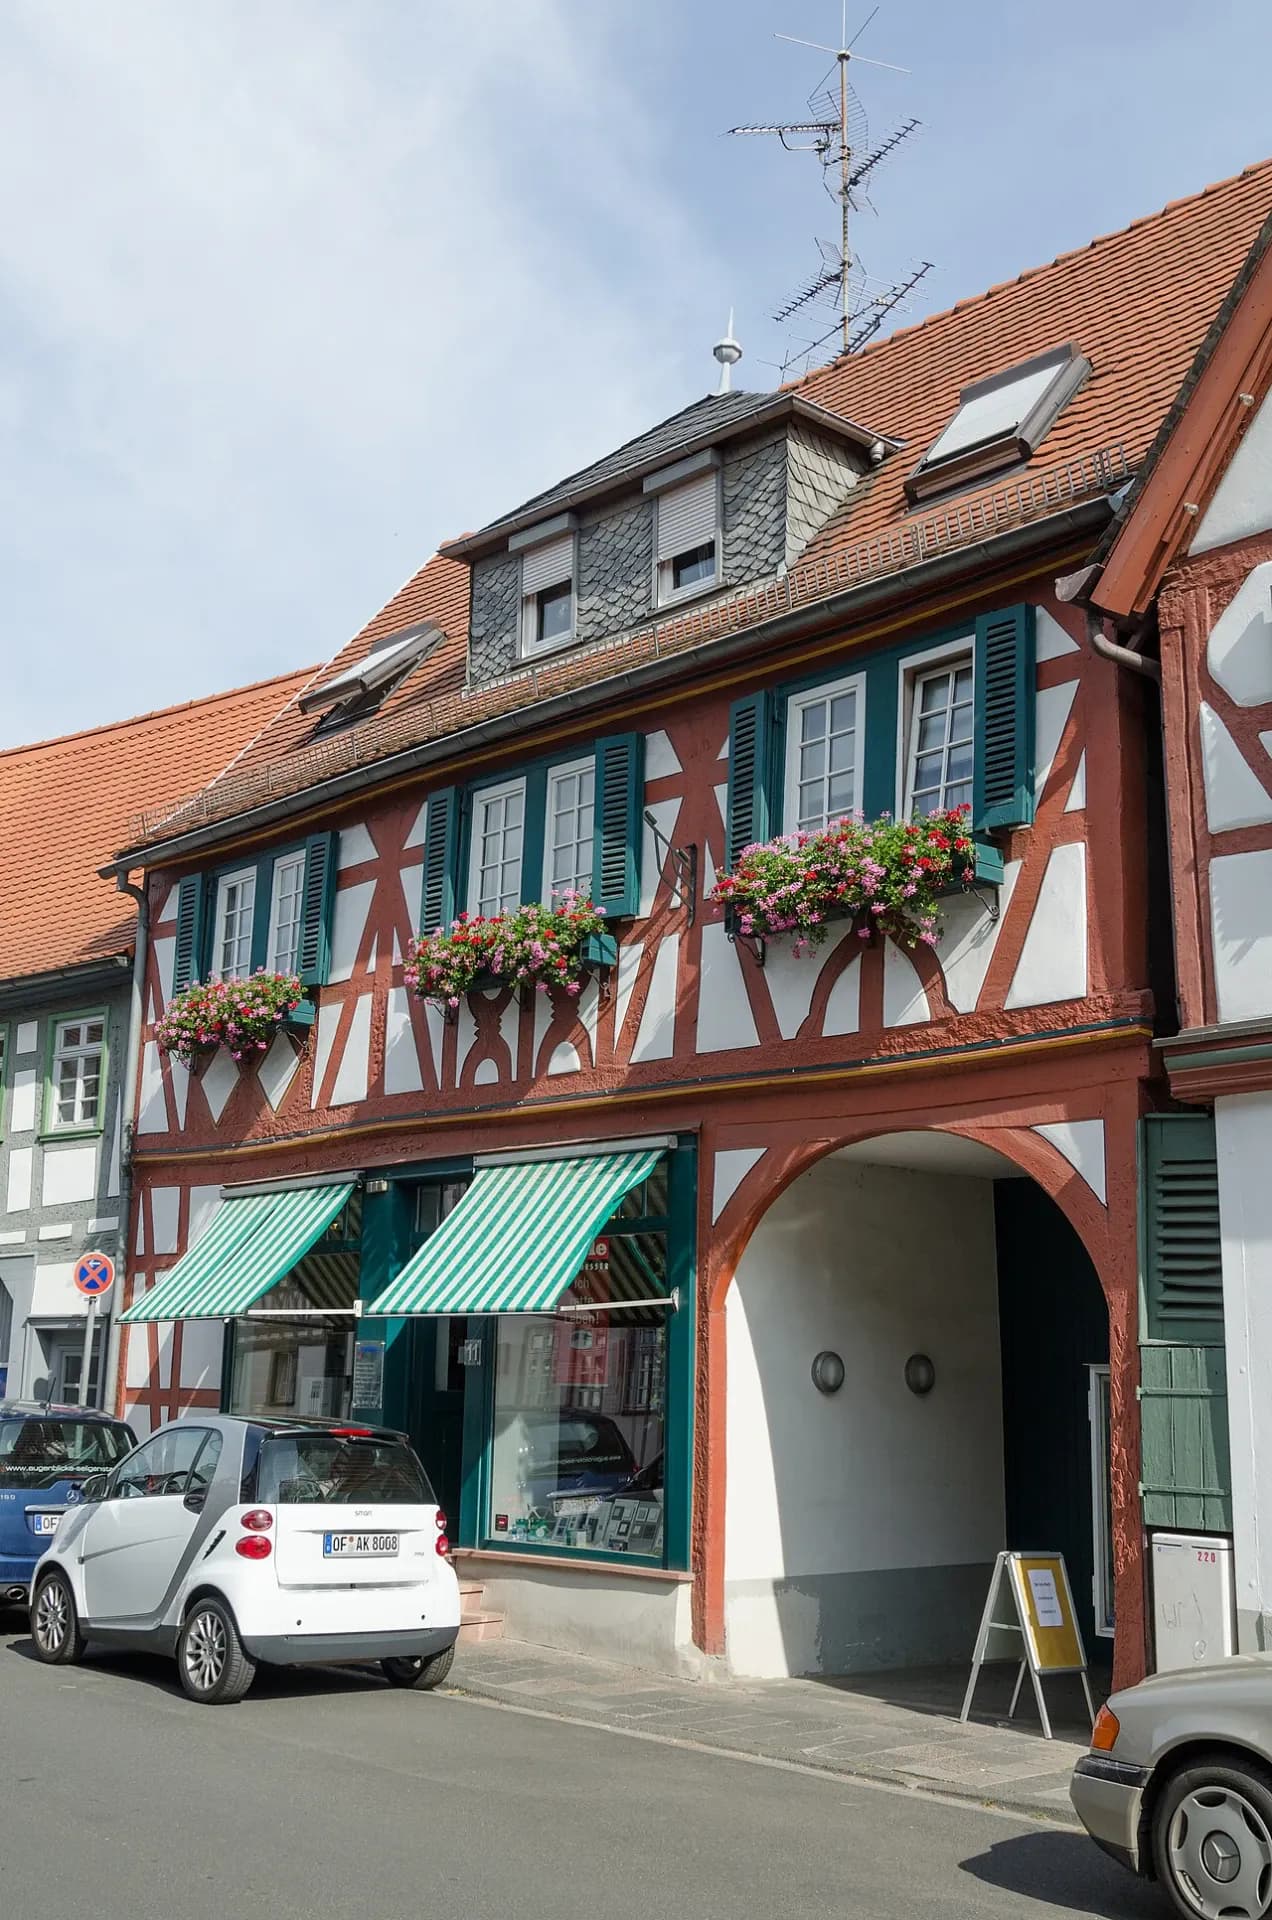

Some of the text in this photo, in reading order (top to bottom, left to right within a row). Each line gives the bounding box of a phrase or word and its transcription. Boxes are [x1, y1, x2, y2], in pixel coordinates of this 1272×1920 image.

[43, 1516, 57, 1530] OF
[333, 1535, 398, 1552] OF AK 8008
[1197, 1551, 1216, 1564] 220
